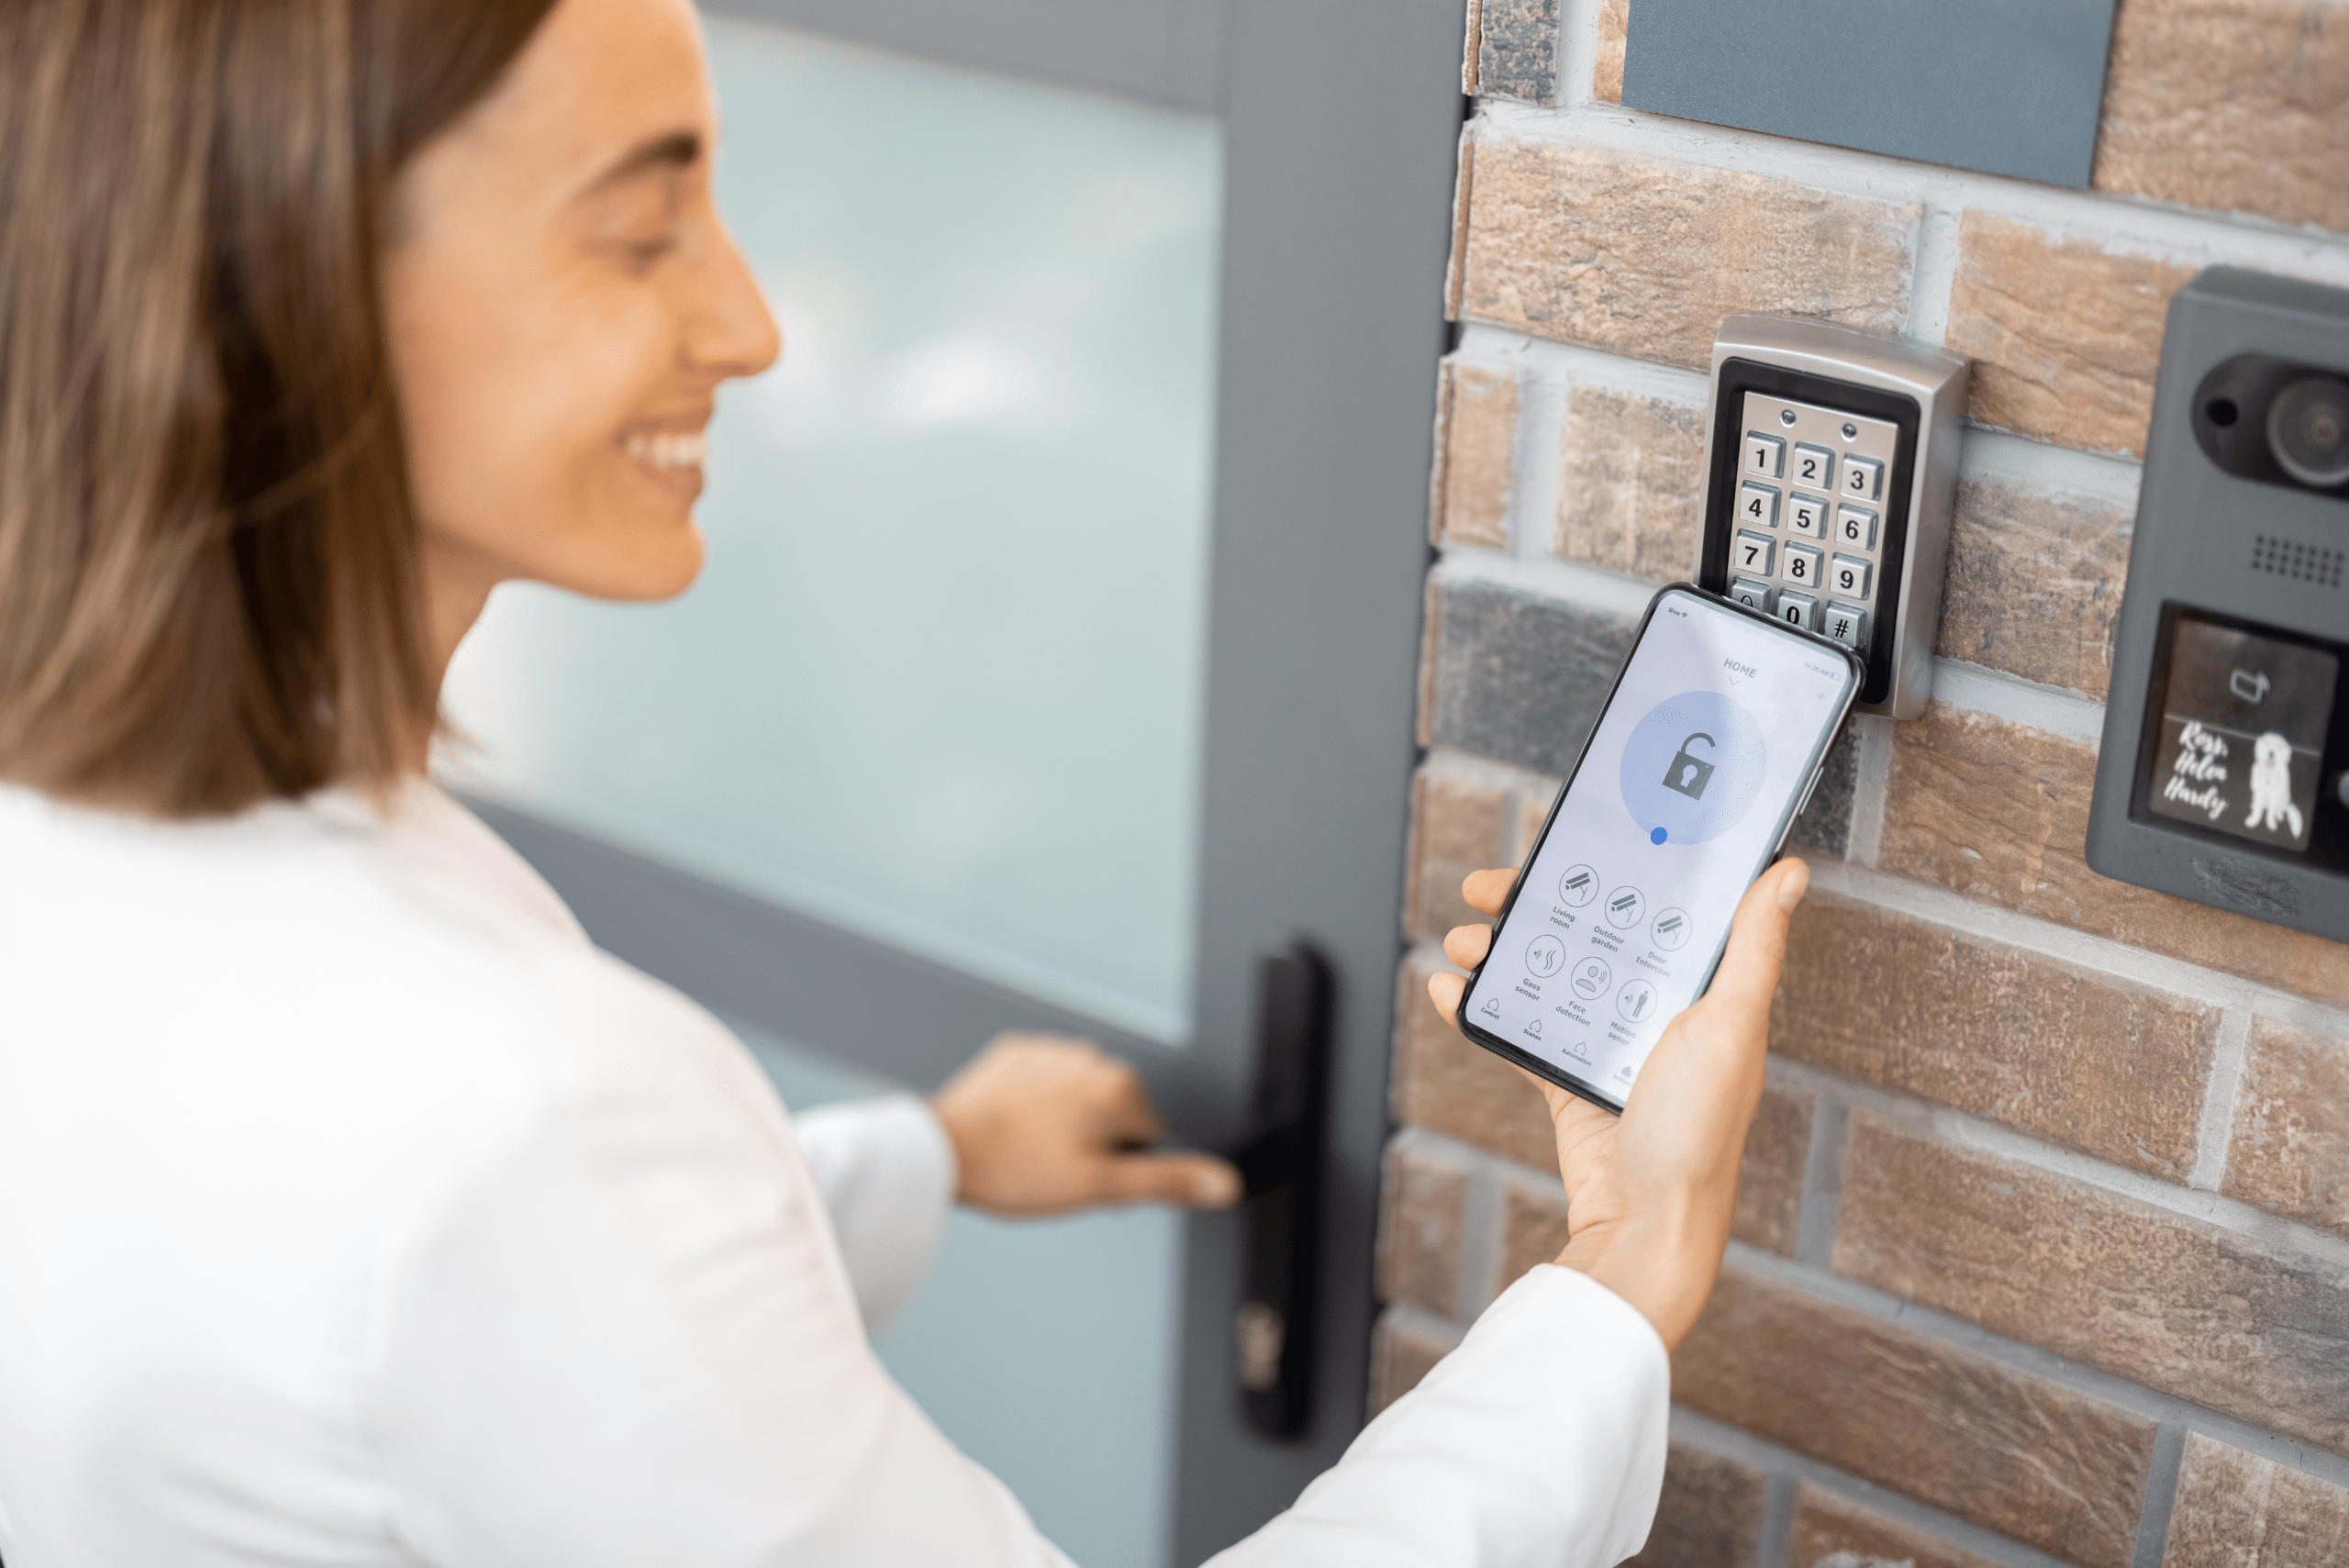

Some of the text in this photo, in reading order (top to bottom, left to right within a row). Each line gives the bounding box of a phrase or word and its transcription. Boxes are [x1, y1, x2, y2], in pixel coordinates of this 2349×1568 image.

[1755, 448, 1865, 491] 1 2 3
[1748, 498, 1859, 540] 4 5 6
[1744, 545, 1854, 590] 7 8 9
[1667, 606, 1681, 617] Blue
[1786, 606, 1850, 639] 0 #
[1723, 658, 1758, 679] HOME
[1550, 916, 1570, 929] room
[1553, 906, 1576, 923] Living
[1594, 926, 1625, 945] Outdoor
[1591, 936, 1620, 953] garden
[1647, 951, 1667, 965] Door
[1635, 956, 1671, 978] Intercom
[1522, 977, 1542, 992] Gass
[1515, 985, 1541, 1002] sensor
[1481, 1006, 1500, 1020] Control
[1568, 1000, 1586, 1014] Face
[1555, 1006, 1591, 1028] detection
[1523, 1029, 1542, 1041] Scenes
[1609, 1020, 1636, 1039] Motion
[1608, 1031, 1631, 1047] senor
[1562, 1048, 1592, 1067] Automation
